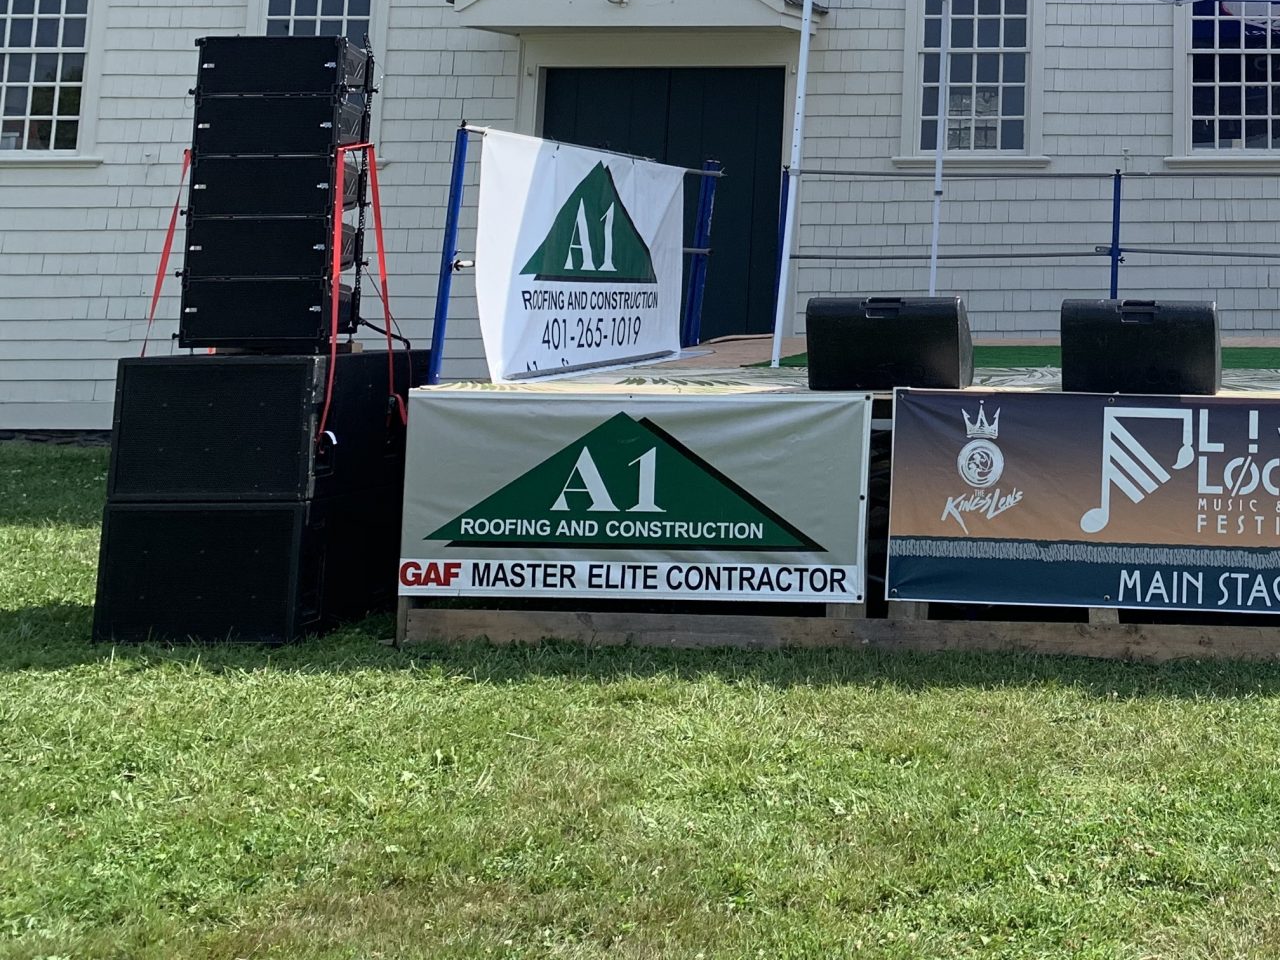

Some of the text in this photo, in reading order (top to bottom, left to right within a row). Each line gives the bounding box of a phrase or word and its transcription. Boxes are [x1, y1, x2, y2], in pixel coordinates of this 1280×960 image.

[563, 197, 618, 272] A1
[521, 290, 658, 310] ROOFING AND CONSTRUCTION
[542, 315, 642, 350] 401-265-1019
[550, 445, 667, 513] A1
[1198, 498, 1257, 512] MUSIC
[460, 517, 765, 540] ROOFING AND CONSTRUCTION
[399, 561, 847, 594] GAF MASTER ELITE CONTRACTOR
[1118, 569, 1203, 605] MAIN
